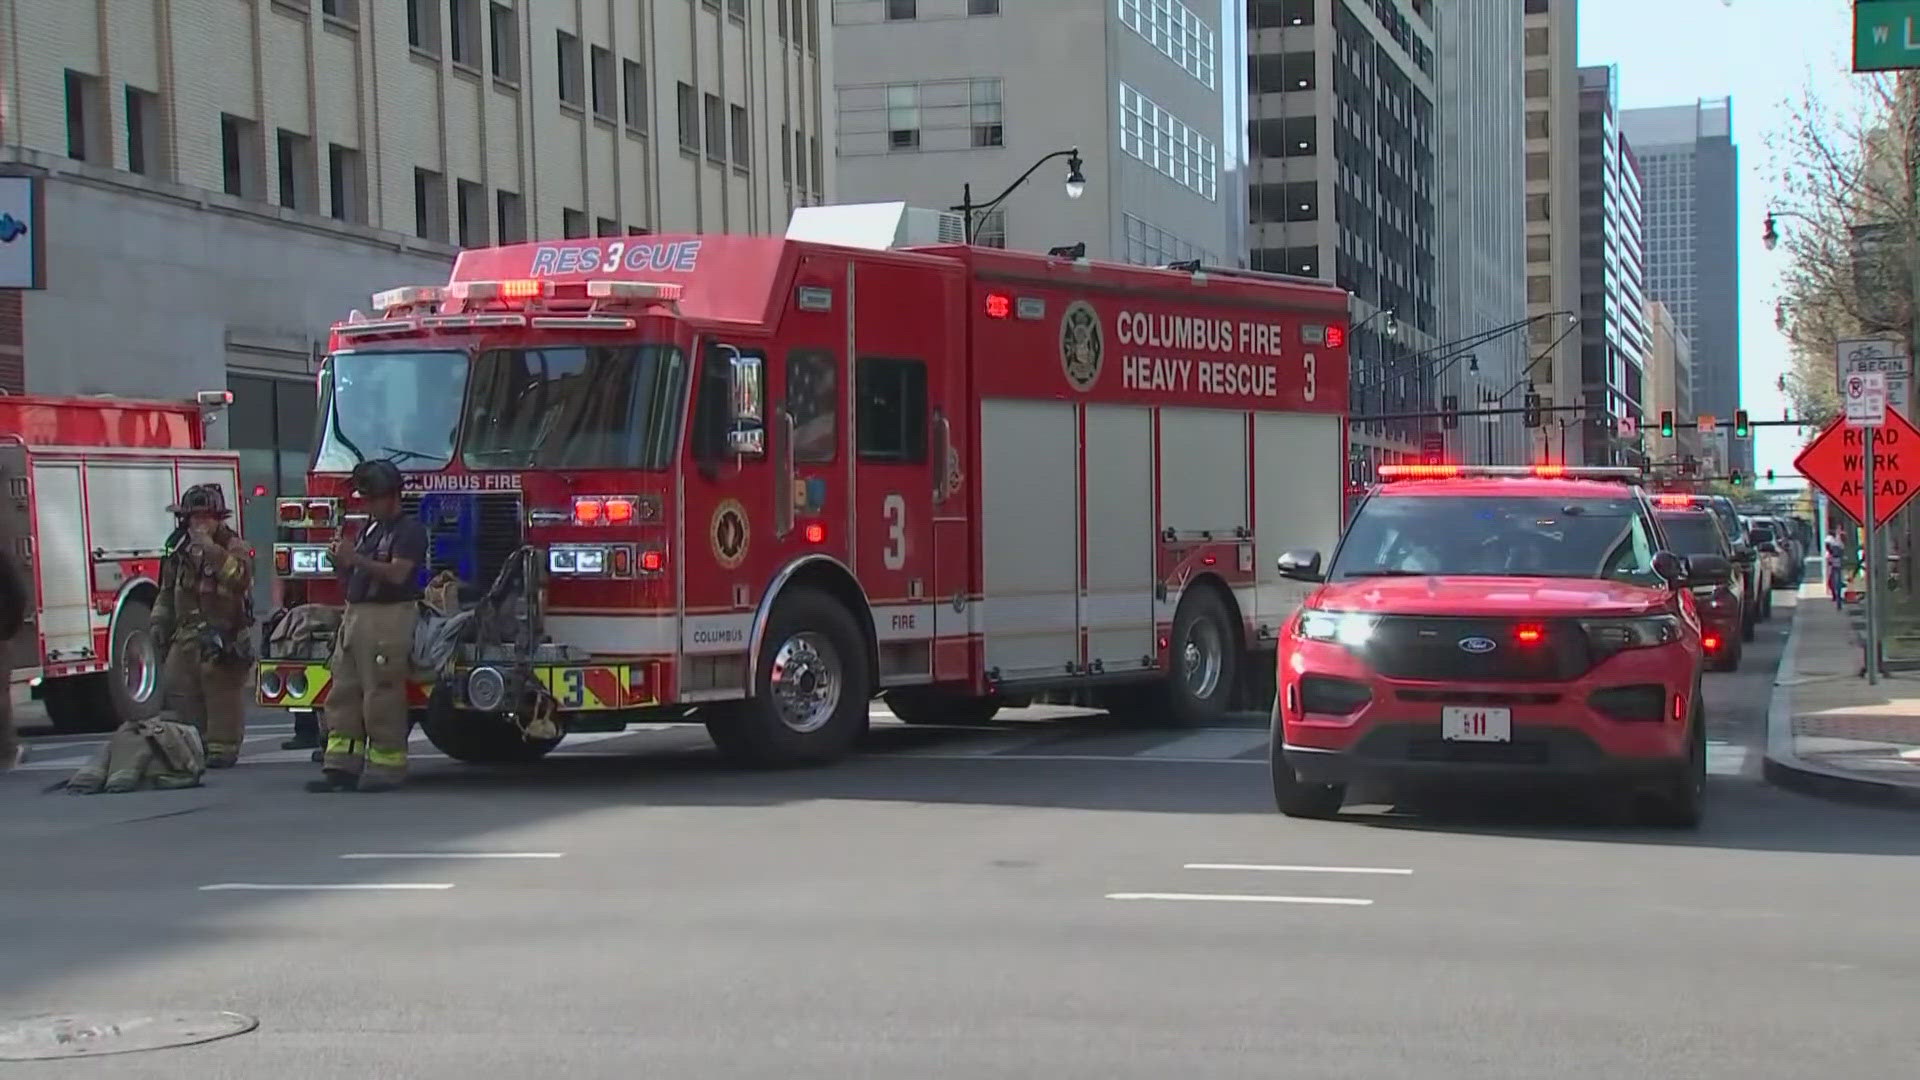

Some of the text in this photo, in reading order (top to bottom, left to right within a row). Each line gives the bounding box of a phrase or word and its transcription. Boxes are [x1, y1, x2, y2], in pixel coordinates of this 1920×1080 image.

[1872, 25, 1889, 45] W
[1117, 311, 1281, 356] COLUMBUS FIRE
[1123, 356, 1276, 396] HEAVY RESCUE
[1304, 352, 1316, 402] 3
[1858, 360, 1903, 372] BEGIN
[401, 473, 522, 490] OLUMBUS FIRE
[883, 495, 905, 570] 3
[892, 615, 916, 631] FIRE
[694, 630, 743, 643] COLUMBUS
[563, 669, 583, 708] 3
[1473, 712, 1486, 736] 11
